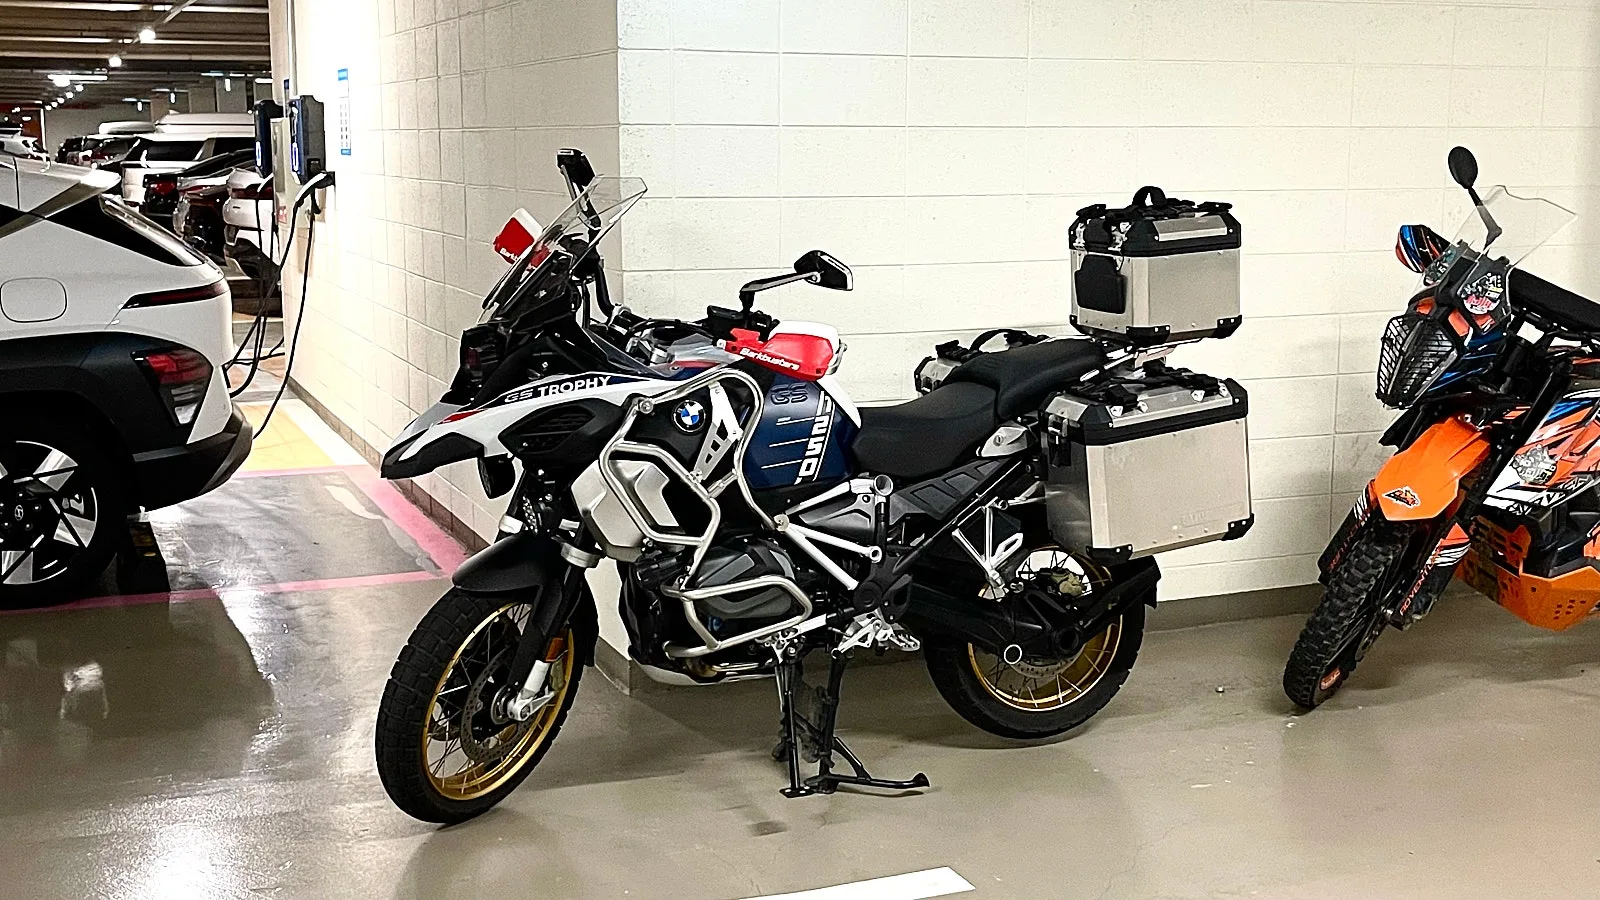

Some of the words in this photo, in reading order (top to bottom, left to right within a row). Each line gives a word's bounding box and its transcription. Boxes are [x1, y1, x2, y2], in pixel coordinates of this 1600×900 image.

[740, 347, 800, 371] Barkbusters
[504, 388, 533, 403] GS
[538, 376, 611, 397] TROPHY
